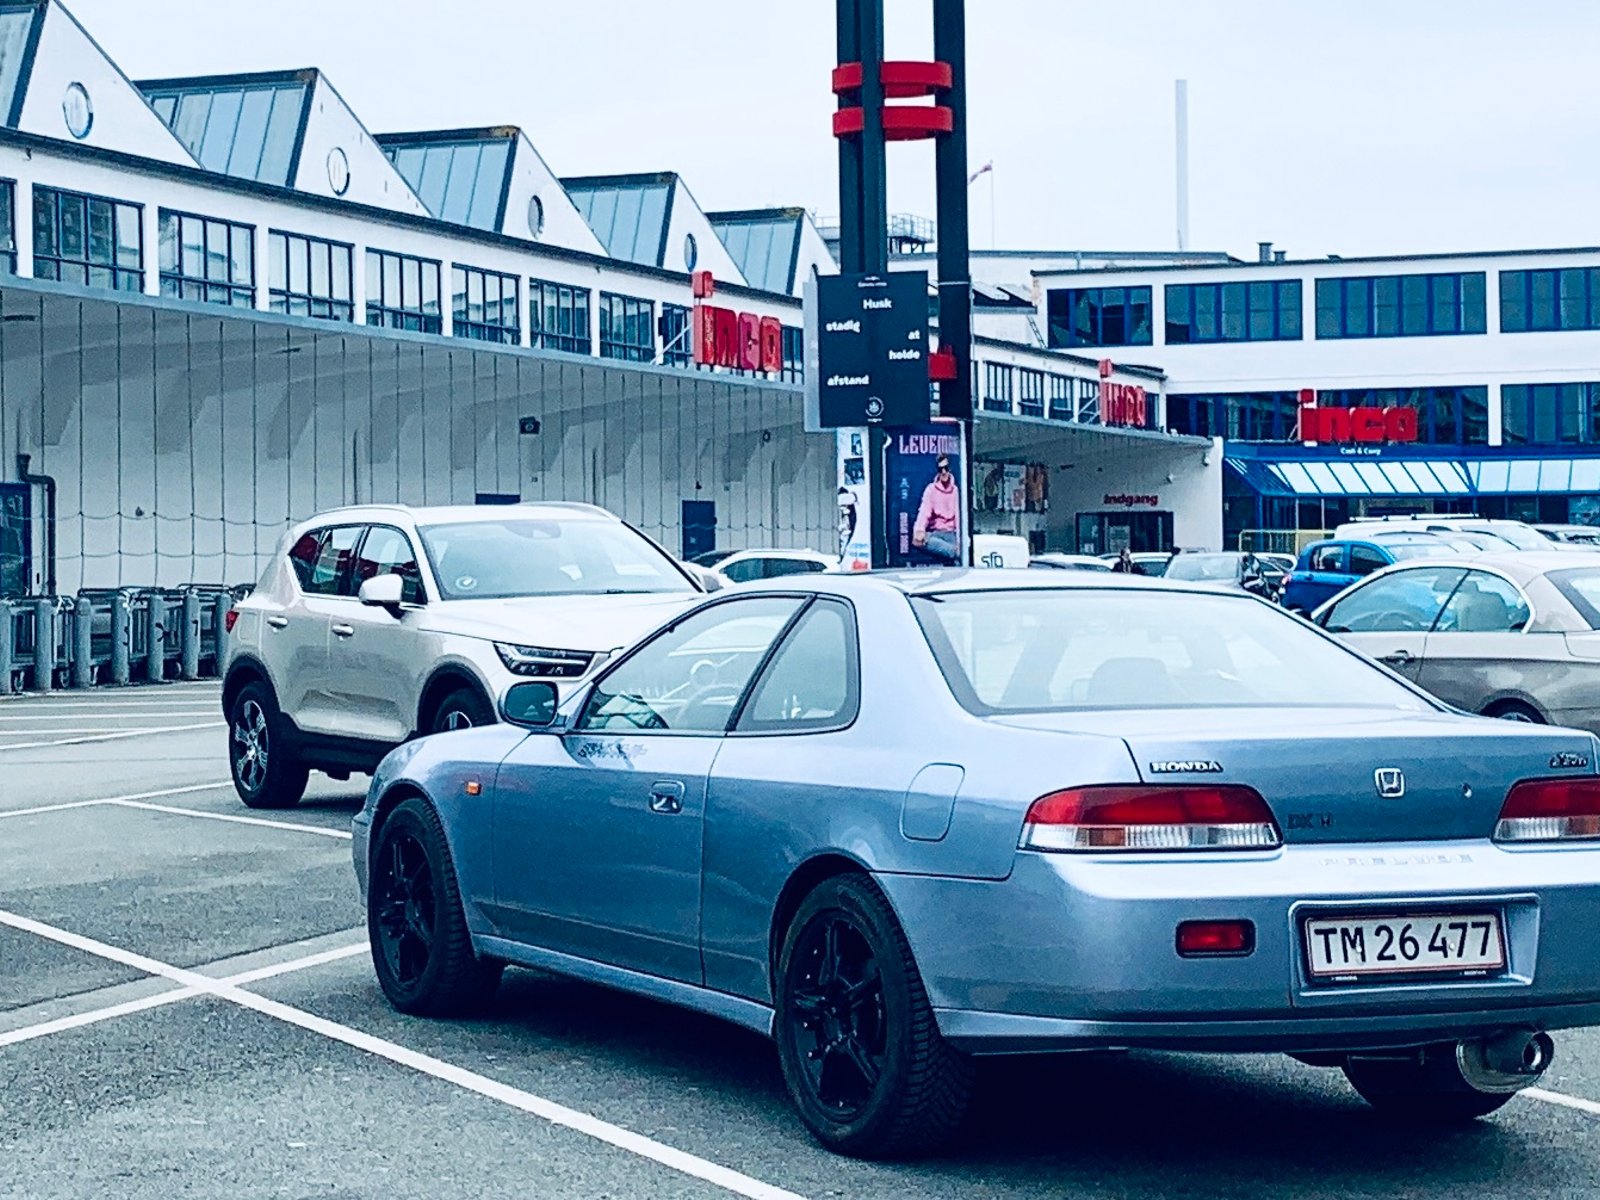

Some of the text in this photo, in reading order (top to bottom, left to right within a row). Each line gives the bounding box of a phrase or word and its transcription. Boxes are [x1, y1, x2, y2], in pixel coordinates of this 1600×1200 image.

[863, 298, 892, 309] Husk
[826, 320, 860, 333] stadig
[908, 330, 920, 340] at
[889, 349, 920, 360] holde
[827, 374, 869, 386] afstand
[1103, 494, 1159, 507] Indgang
[1151, 761, 1221, 773] HONDA
[1314, 921, 1492, 964] TM 26 477
